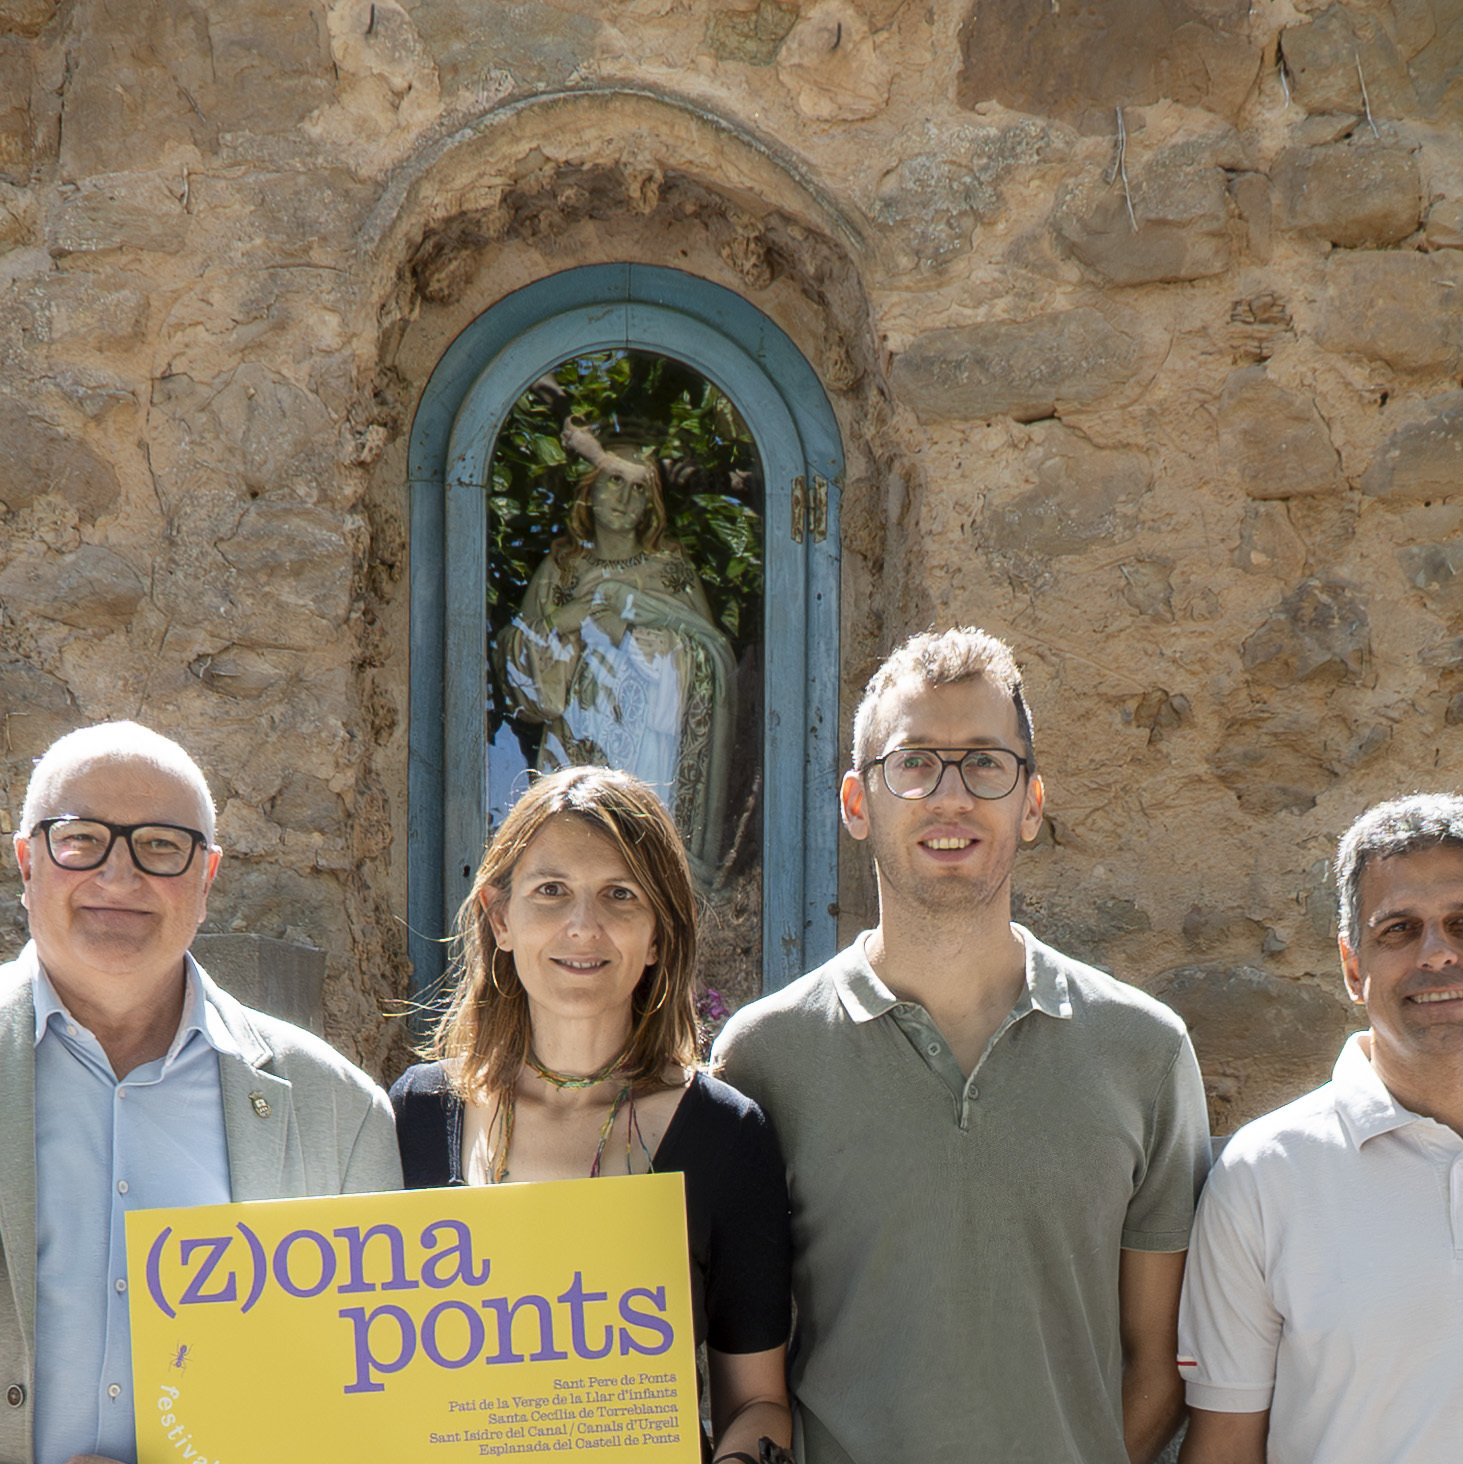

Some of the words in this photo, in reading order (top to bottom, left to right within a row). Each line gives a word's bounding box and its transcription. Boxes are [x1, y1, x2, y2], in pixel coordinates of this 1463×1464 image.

[145, 1219, 491, 1319] (z)ona
[338, 1271, 675, 1394] ponts
[553, 1378, 585, 1390] Sant
[588, 1375, 618, 1388] Pere
[620, 1374, 635, 1386] de
[638, 1372, 677, 1385] Ponts
[449, 1399, 476, 1412] Pati
[479, 1398, 494, 1410] de
[496, 1397, 509, 1409] la
[512, 1395, 549, 1410] Verge
[552, 1393, 568, 1405] de
[570, 1392, 583, 1404] la
[586, 1390, 615, 1403] Llar
[488, 1412, 528, 1425] Santa
[578, 1407, 594, 1418] de
[596, 1402, 678, 1418] Torreblanca
[429, 1430, 461, 1443] Sant
[463, 1428, 503, 1441] Isidre
[506, 1426, 525, 1439] del
[528, 1424, 567, 1437] Canal
[577, 1420, 623, 1434] Canals
[479, 1441, 551, 1457] Esplanada
[553, 1438, 573, 1451] del
[575, 1435, 621, 1449] Castell
[624, 1434, 639, 1446] de
[641, 1431, 680, 1445] Ponts
